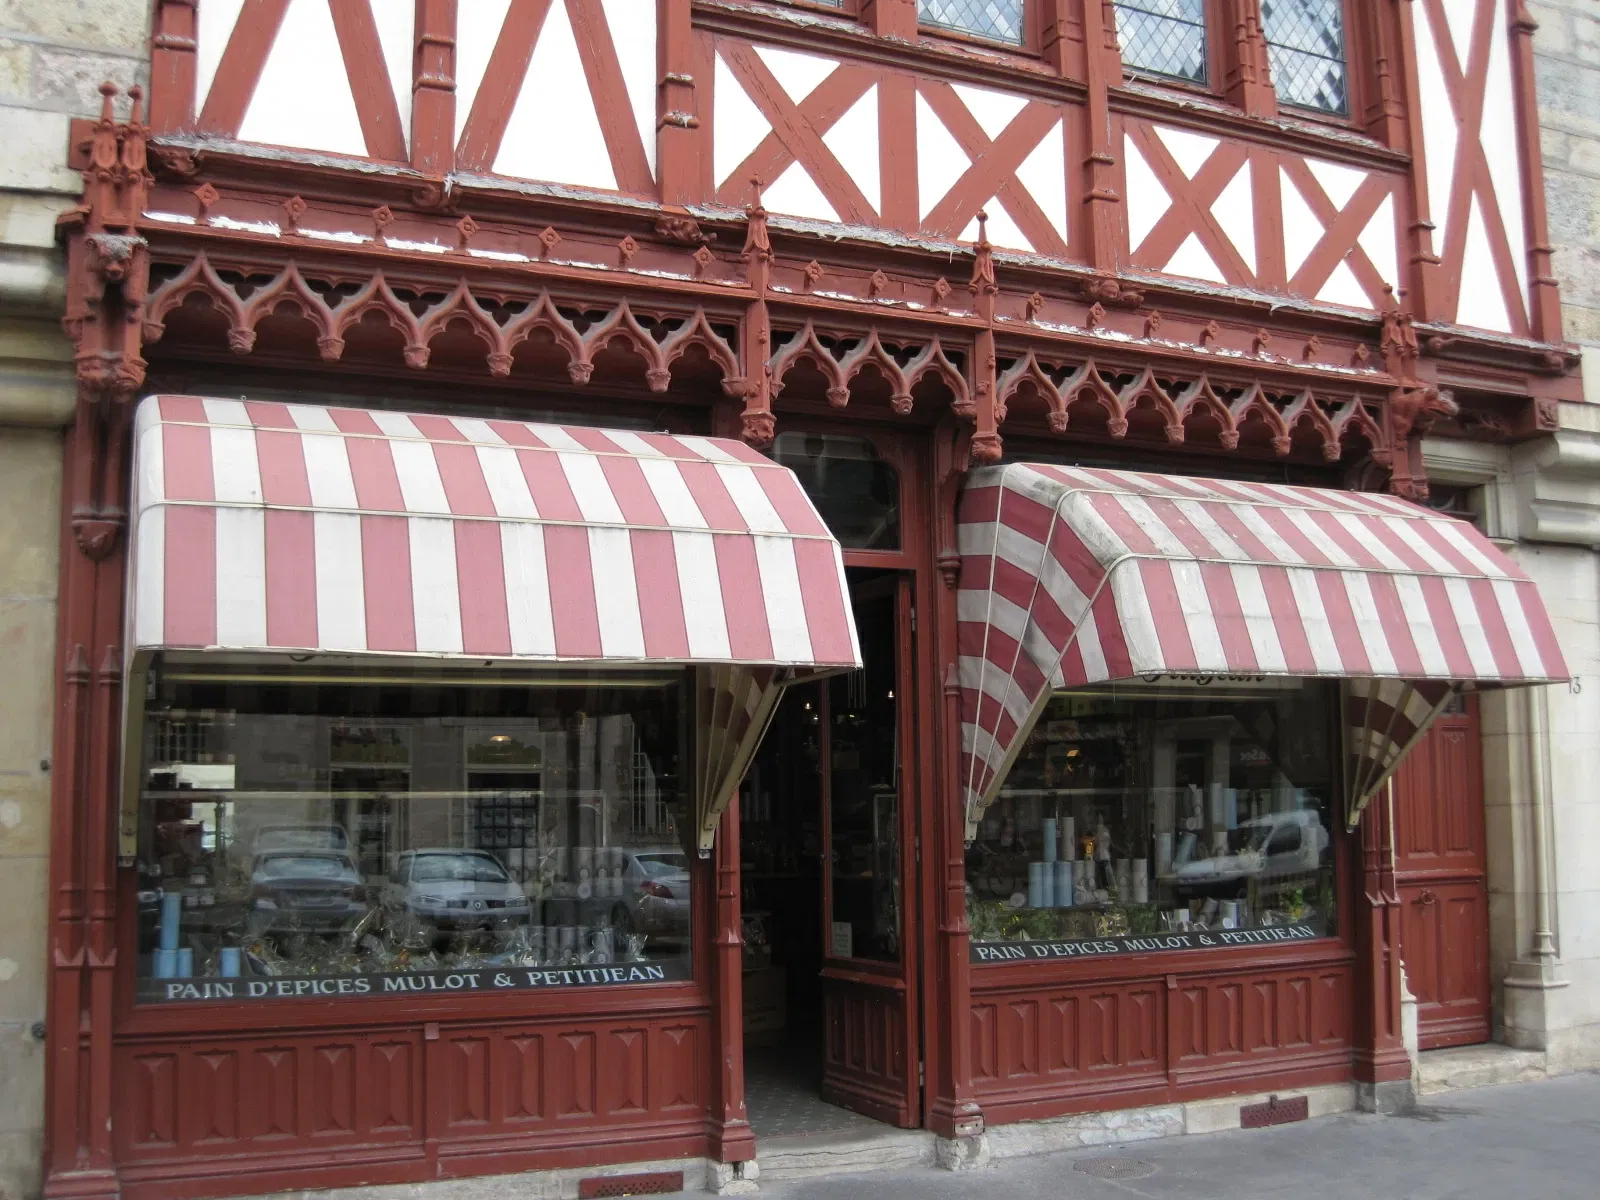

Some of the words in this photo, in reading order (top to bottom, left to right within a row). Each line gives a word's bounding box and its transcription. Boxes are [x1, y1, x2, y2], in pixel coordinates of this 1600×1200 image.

[976, 945, 1027, 960] PAIN
[1033, 939, 1119, 957] D'EPICES
[1125, 936, 1191, 950] MULOT
[1199, 932, 1217, 945] &
[1222, 925, 1315, 943] PETITJEAN
[167, 983, 234, 999] PAIN
[249, 977, 371, 997] D'EPICES
[383, 974, 480, 990] MULOT
[493, 970, 516, 987] &
[527, 965, 665, 986] PETITJEAN
